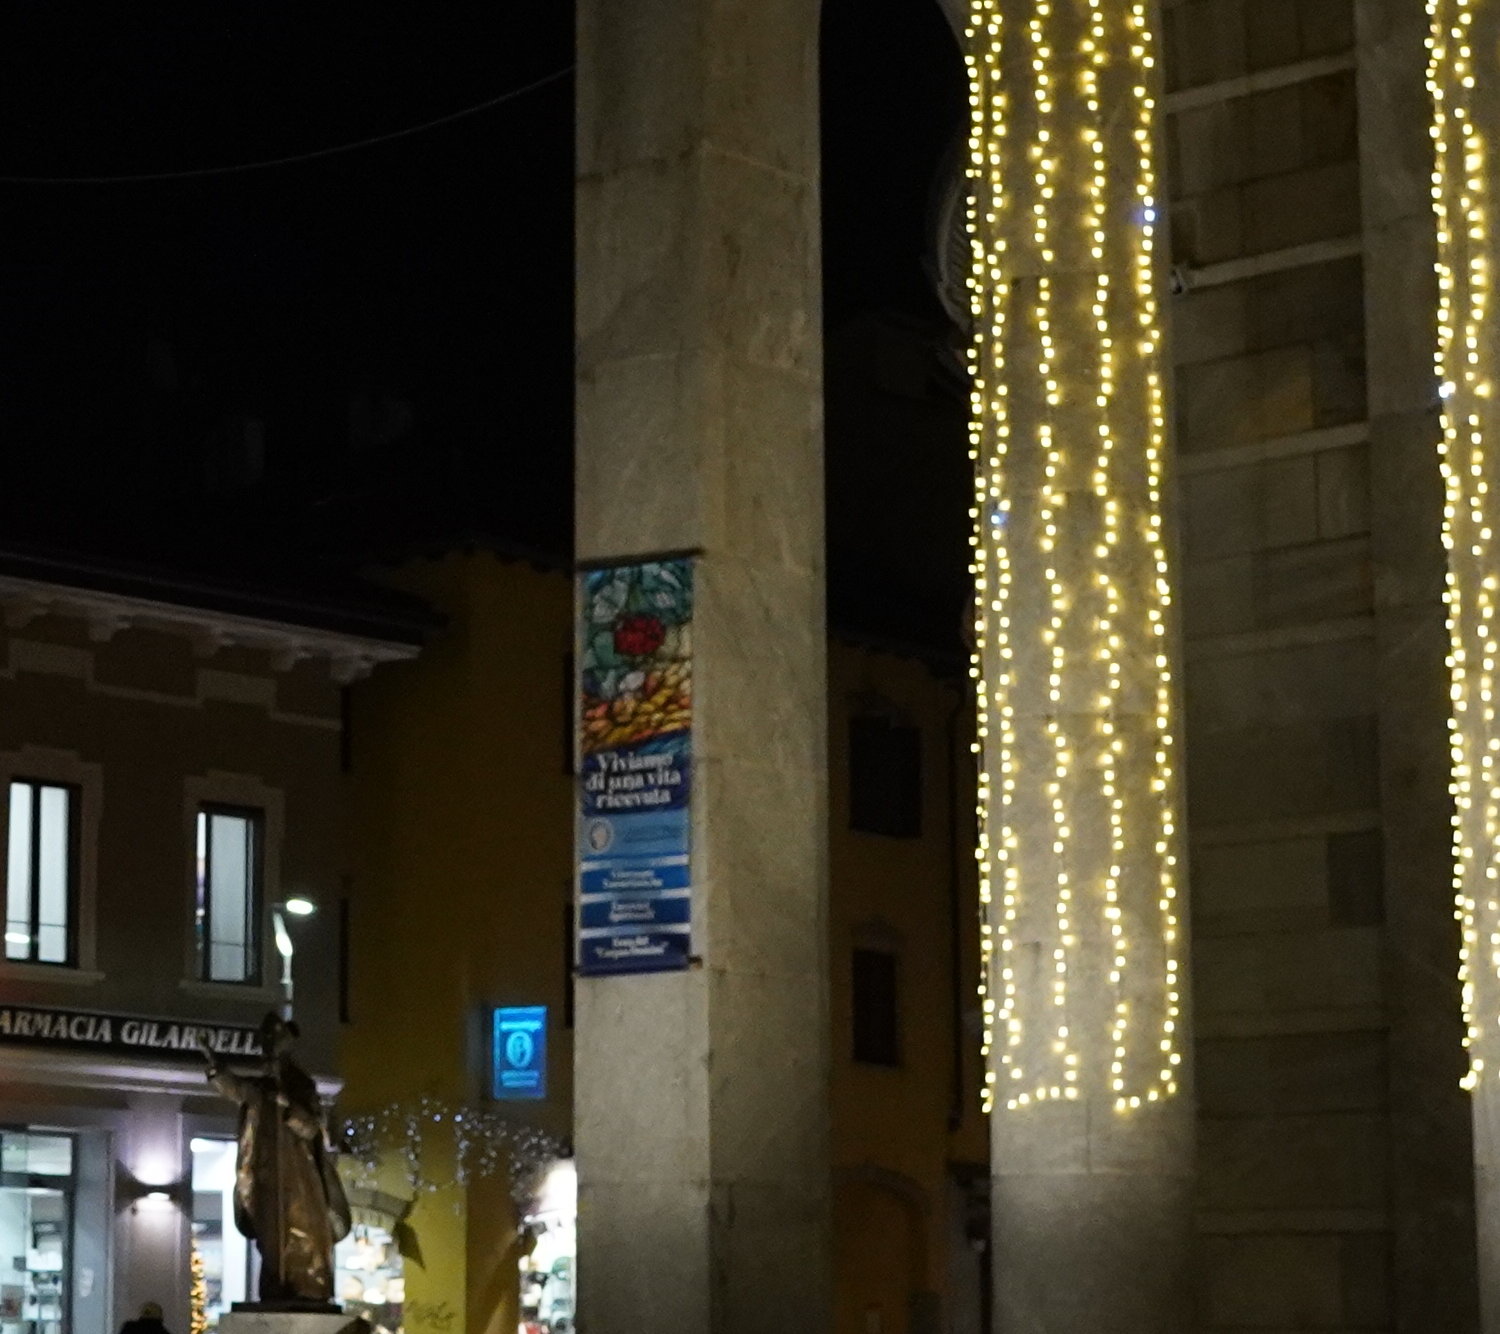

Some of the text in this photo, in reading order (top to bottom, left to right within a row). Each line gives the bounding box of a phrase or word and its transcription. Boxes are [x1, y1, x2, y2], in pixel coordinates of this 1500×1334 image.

[596, 751, 675, 772] Viviamo
[586, 771, 605, 791] di
[646, 766, 681, 786] vita
[596, 788, 672, 809] ricevuta
[120, 1020, 263, 1056] GILARDELL
